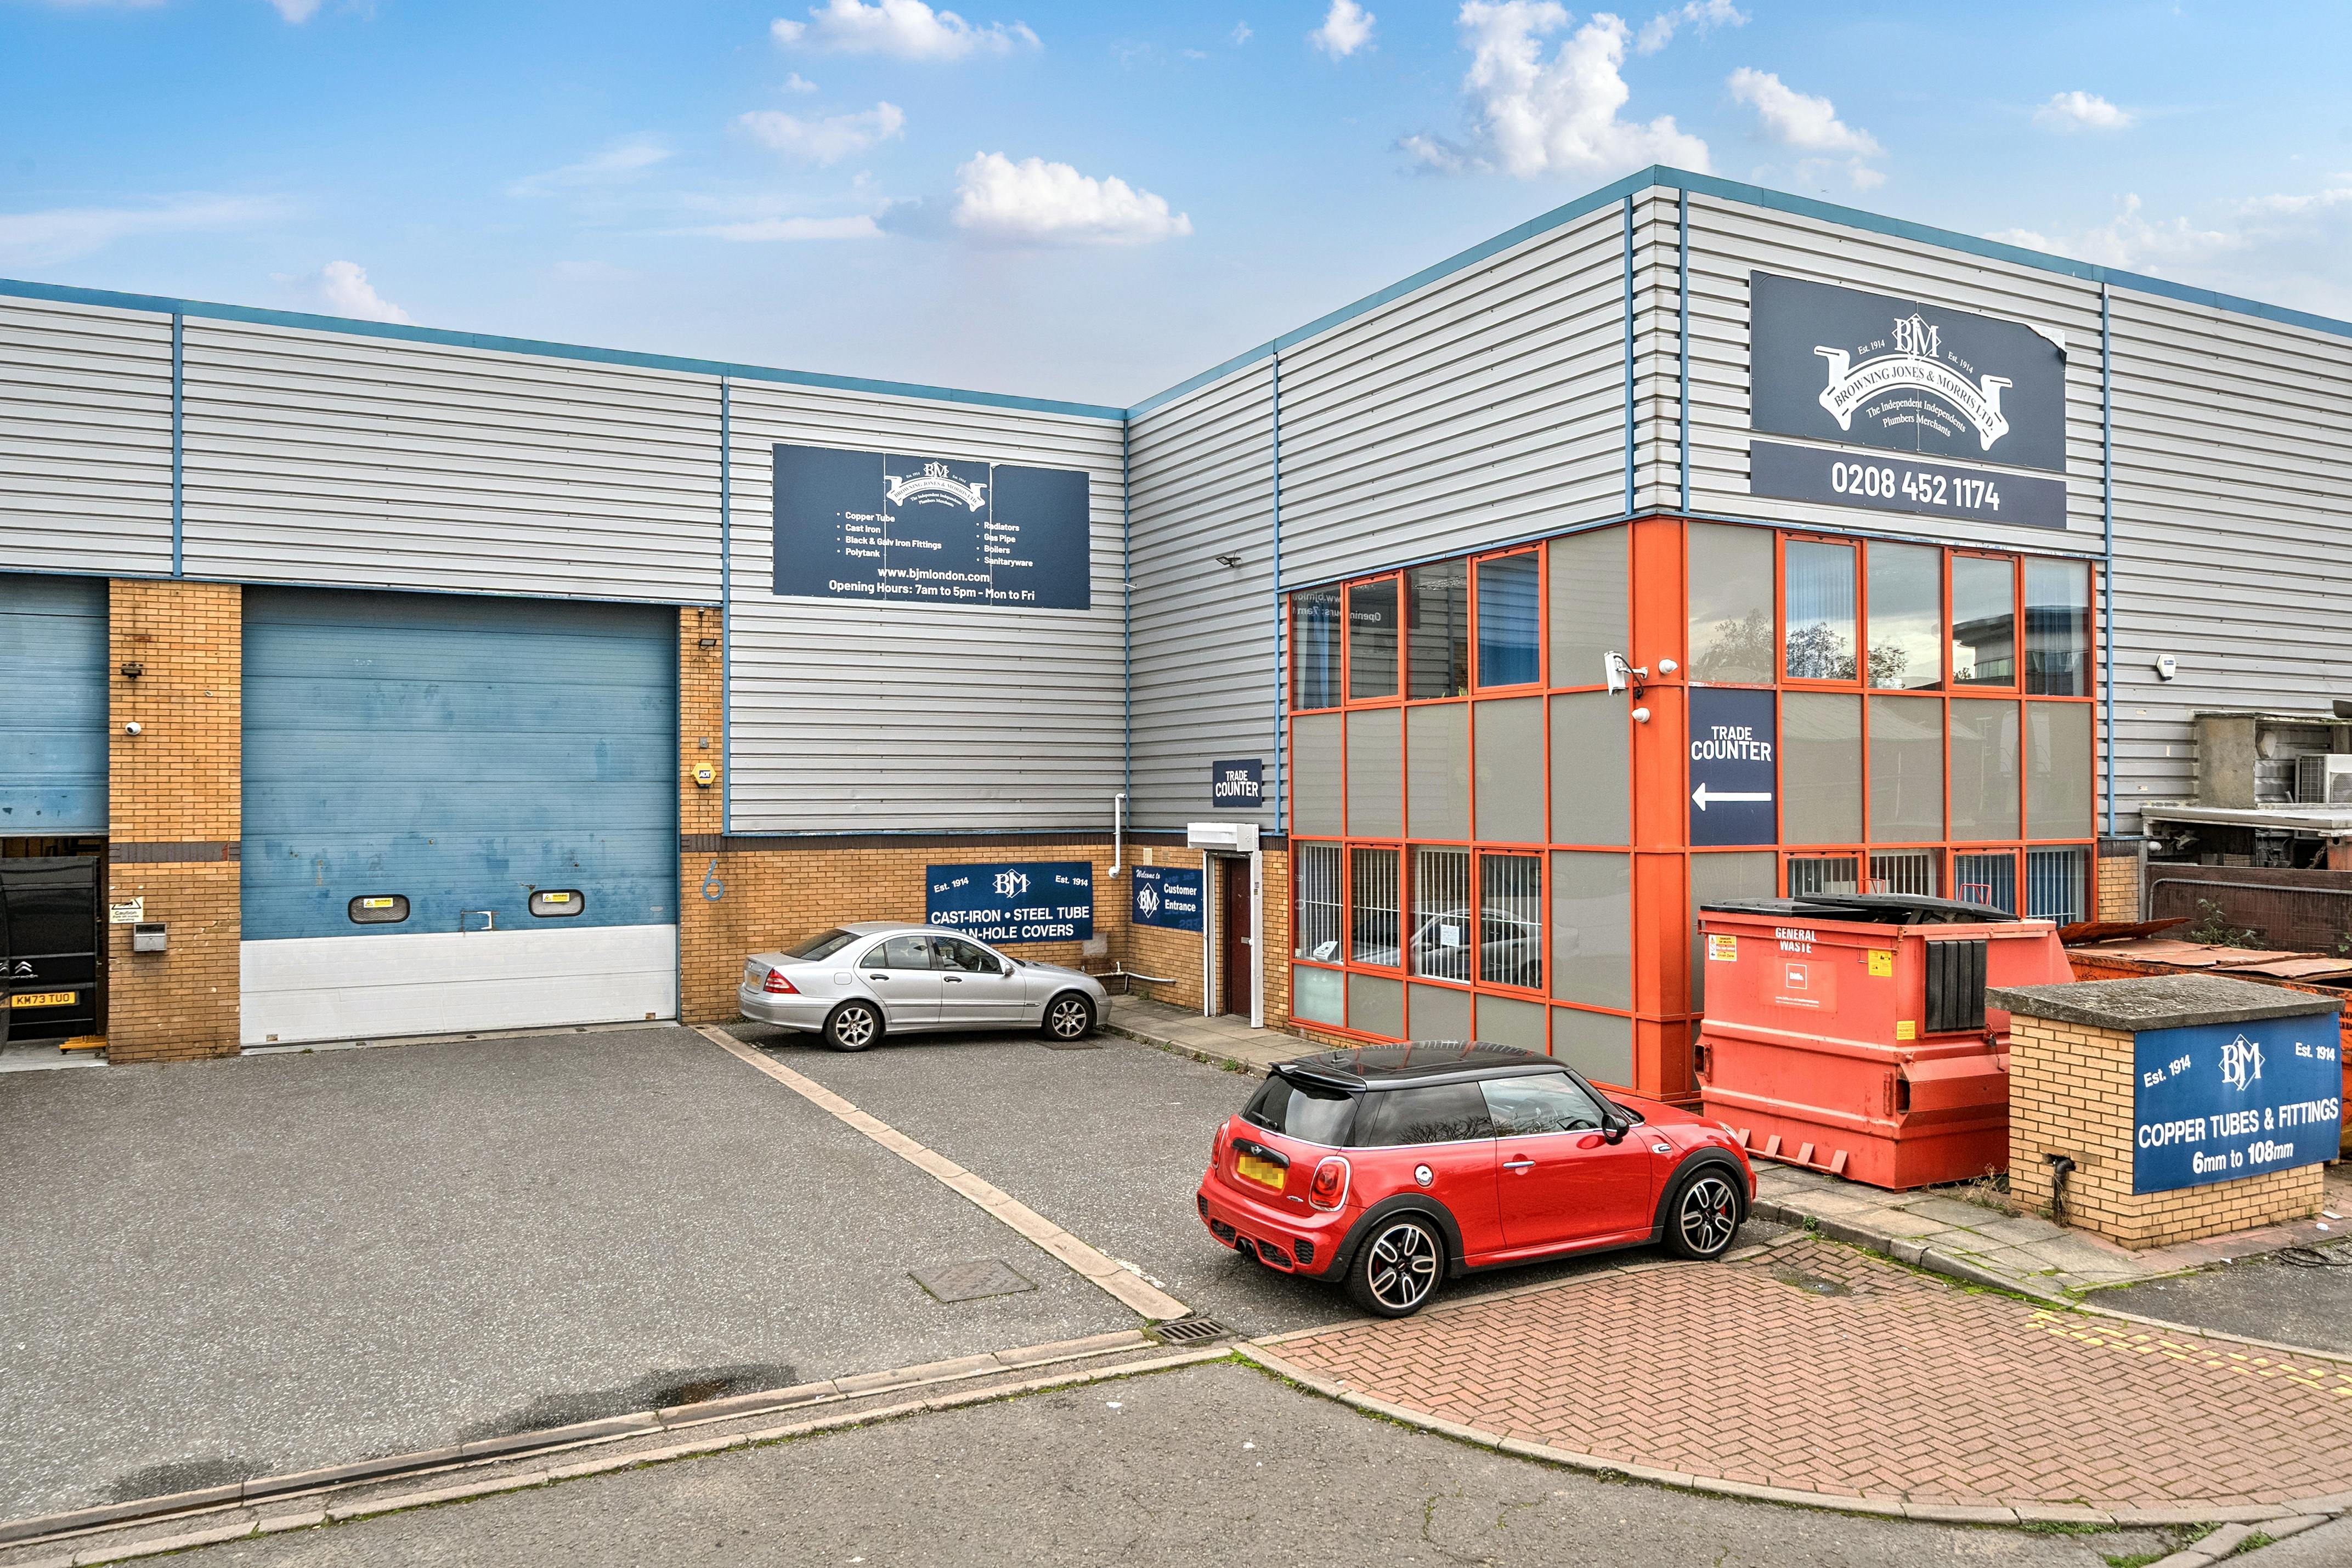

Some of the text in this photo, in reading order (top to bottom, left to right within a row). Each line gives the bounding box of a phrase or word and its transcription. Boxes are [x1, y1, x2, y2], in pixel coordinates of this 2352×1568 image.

[1858, 339, 1885, 355] Est. 1914
[1947, 351, 1974, 373] Est. 1914
[1834, 366, 1994, 431] BROWNING JONES & MORRIS LTD.
[1866, 398, 1966, 433] The Independent Independents
[1882, 414, 1951, 437] Plumbers Merchants
[895, 482, 923, 497] BROWNING
[947, 484, 967, 496] MORRIS
[1832, 462, 2000, 511] 0208 452 1174
[936, 499, 954, 507] Merchants
[845, 512, 895, 522] Copper Tube
[845, 524, 864, 532] Cast
[984, 522, 1020, 531] Radiators
[845, 536, 868, 545] Black
[877, 538, 894, 546] Galv
[912, 540, 942, 550] Fittings
[984, 533, 1016, 544] Gas Pipe
[846, 548, 880, 558] Polytank
[984, 545, 1010, 554] Boilers
[984, 557, 1033, 567] Sanitaryware
[878, 568, 990, 582] www.bjmlondon.com
[829, 579, 875, 595] Opening
[877, 582, 913, 594] Hours:
[915, 584, 938, 596] 7am
[940, 586, 951, 596] to
[953, 587, 976, 598] 5pm
[985, 588, 1006, 599] Mon
[1009, 590, 1020, 600] to
[1021, 591, 1035, 601] Fri
[1711, 726, 1752, 740] TRADE
[1691, 740, 1771, 761] COUNTER
[1225, 770, 1248, 781] TRADE
[1215, 781, 1258, 797] COUNTER
[702, 859, 725, 901] 6
[1055, 875, 1088, 887] Est. 1914
[1136, 869, 1155, 879] Welcome
[934, 877, 969, 893] Est. 1914
[1164, 883, 1197, 896] Customer
[1165, 899, 1196, 912] Entrance
[931, 906, 1089, 925] CAST-IRON STEEL TUBE
[1021, 924, 1074, 938] COVERS
[1775, 927, 1817, 941] GENERAL
[1780, 940, 1812, 953] WASTE
[16, 995, 45, 1005] KM73
[48, 994, 70, 1003] TUO
[2296, 1042, 2335, 1061] Est. 1914
[2144, 1054, 2191, 1088] Est. 1914
[2139, 1097, 2339, 1148] COPPER TUBES & FITTINGS
[2193, 1140, 2293, 1174] 6mm to 108mm
